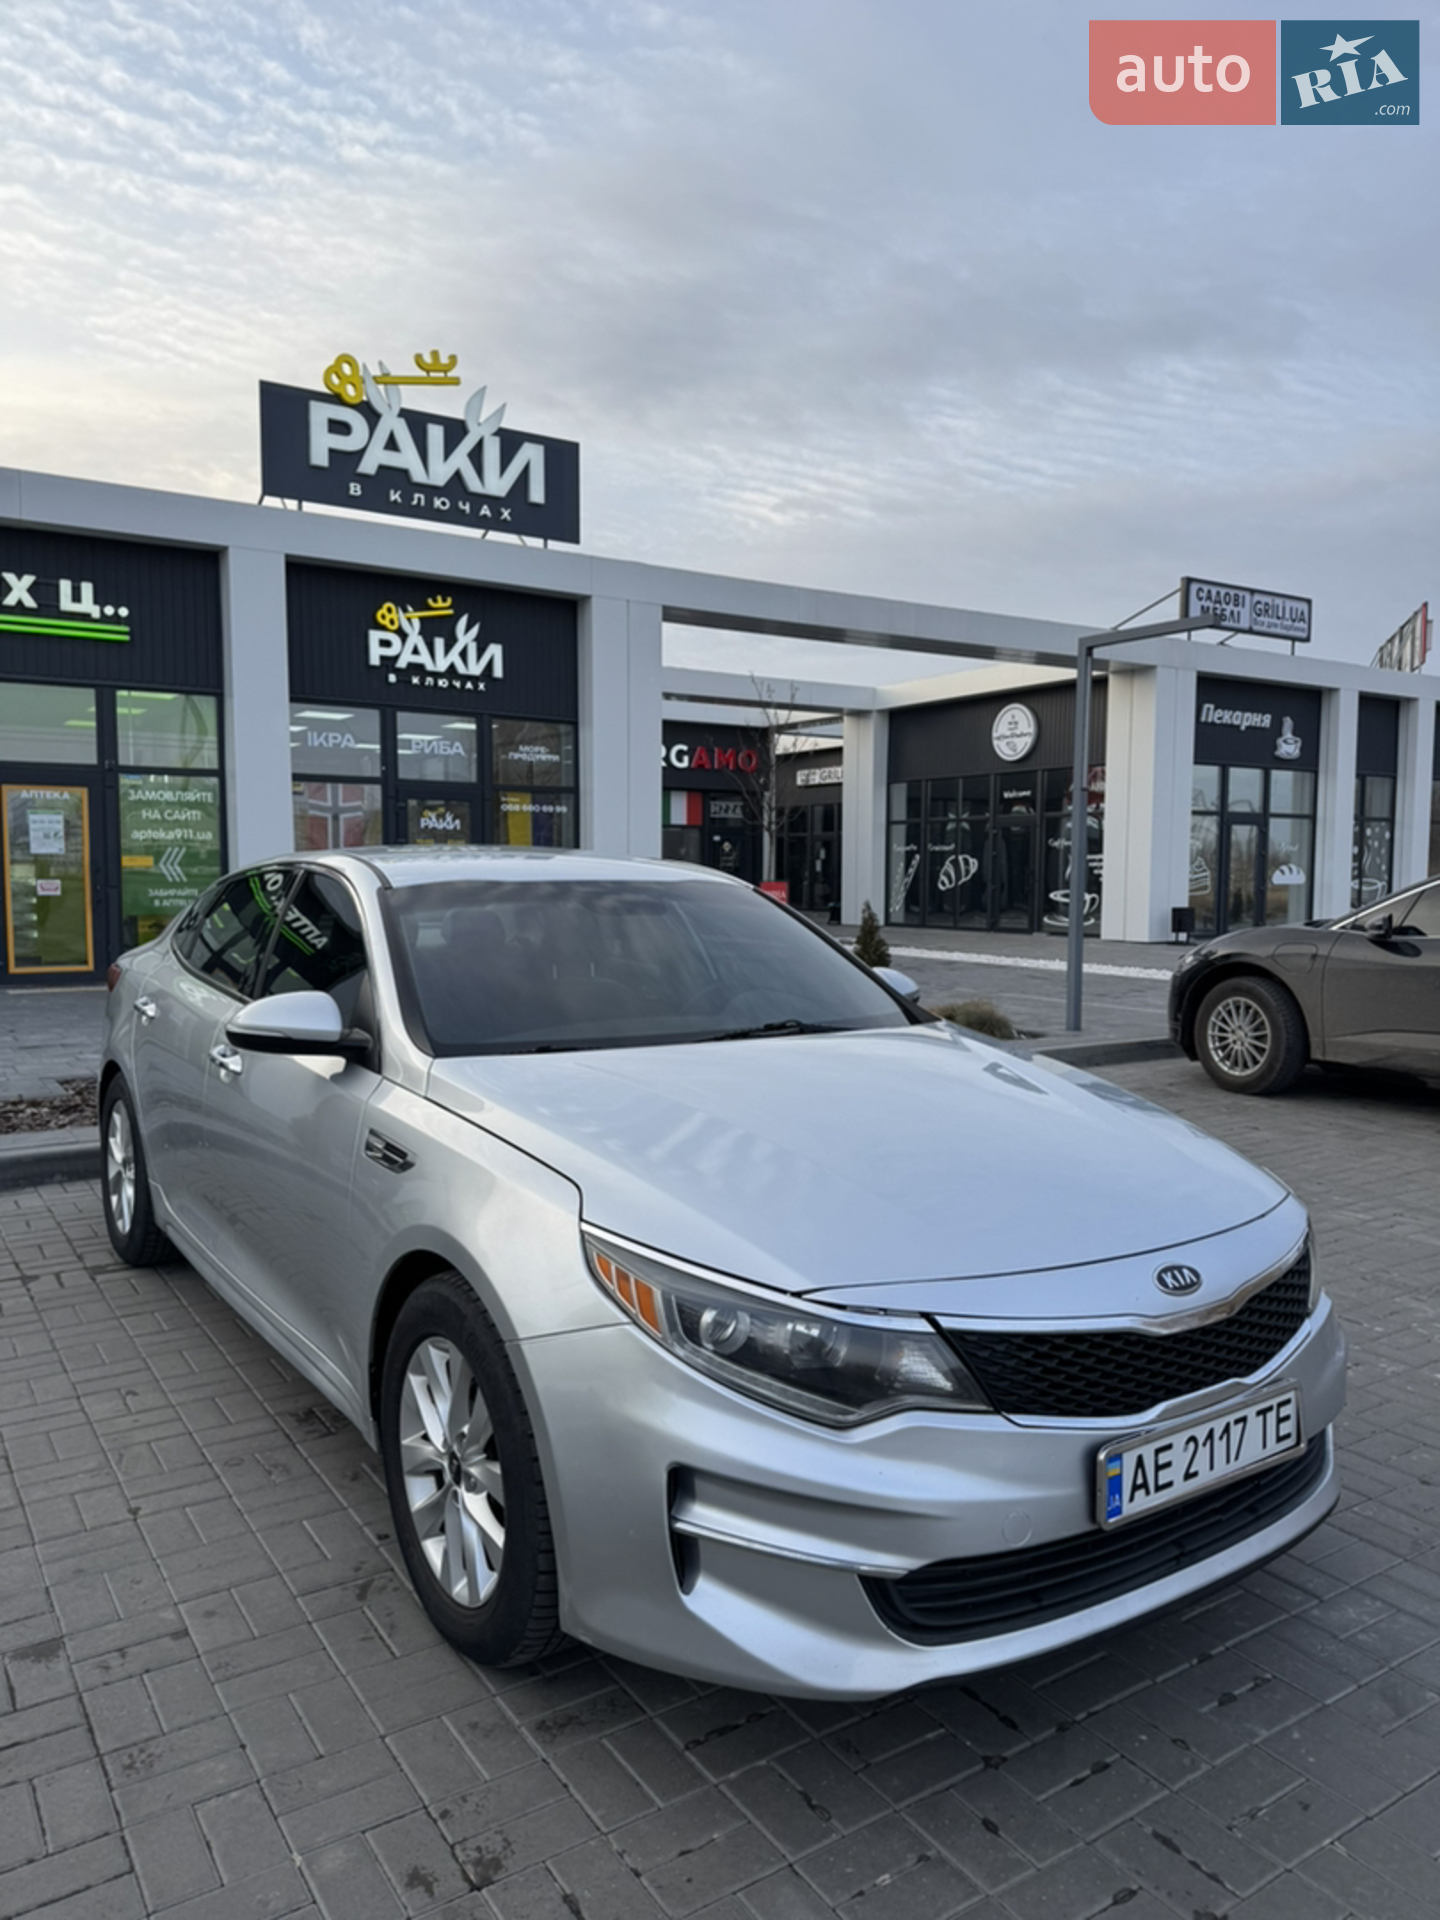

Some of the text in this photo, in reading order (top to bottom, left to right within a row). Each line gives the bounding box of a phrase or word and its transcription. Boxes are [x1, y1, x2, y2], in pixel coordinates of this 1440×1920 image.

[308, 382, 545, 505] РАКИ
[350, 482, 512, 521] В КЛЮЧАХ
[1196, 587, 1245, 609] САДОВІ
[368, 616, 504, 679] РАКИ
[387, 673, 486, 691] В КЛЮЧАХ
[1200, 703, 1272, 731] Пекарня
[307, 731, 356, 749] ІКРА
[411, 739, 467, 758] РИБА
[20, 789, 70, 800] АПТЕКА
[127, 789, 214, 803] ЗАМОВЛЯЙТЕ
[1003, 789, 1032, 799] Welcome
[141, 809, 161, 820] НА
[420, 813, 461, 830] РАКИ
[1162, 1267, 1197, 1289] KIA
[1129, 1398, 1293, 1503] AE 2117 TE
